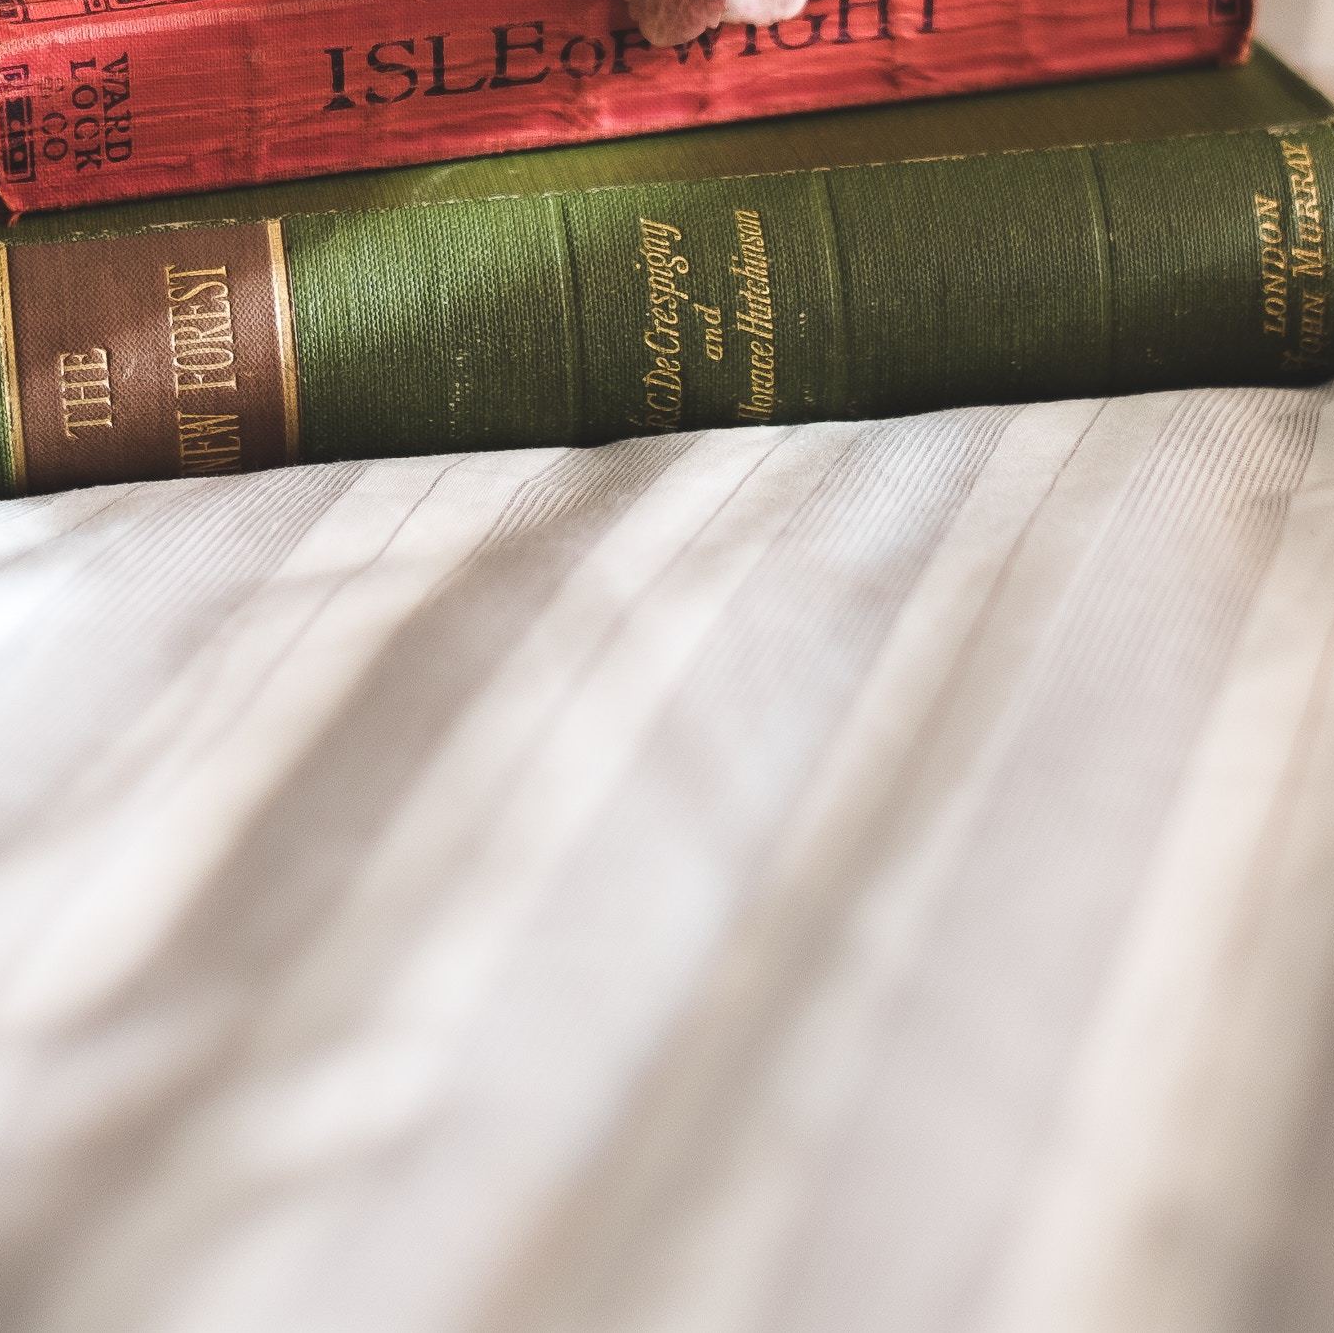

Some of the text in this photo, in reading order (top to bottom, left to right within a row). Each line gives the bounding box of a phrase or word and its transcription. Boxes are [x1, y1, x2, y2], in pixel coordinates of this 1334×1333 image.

[69, 57, 103, 171] LOCK
[101, 51, 133, 163] WARD
[322, 20, 551, 111] ISLE
[560, 29, 651, 79] OF
[1253, 190, 1287, 338] LONDON
[1280, 140, 1324, 277] MURRAY
[165, 265, 241, 474] NEW FOREST
[693, 303, 724, 361] and
[731, 209, 776, 421] Horace Hutchinson
[59, 347, 113, 440] THE
